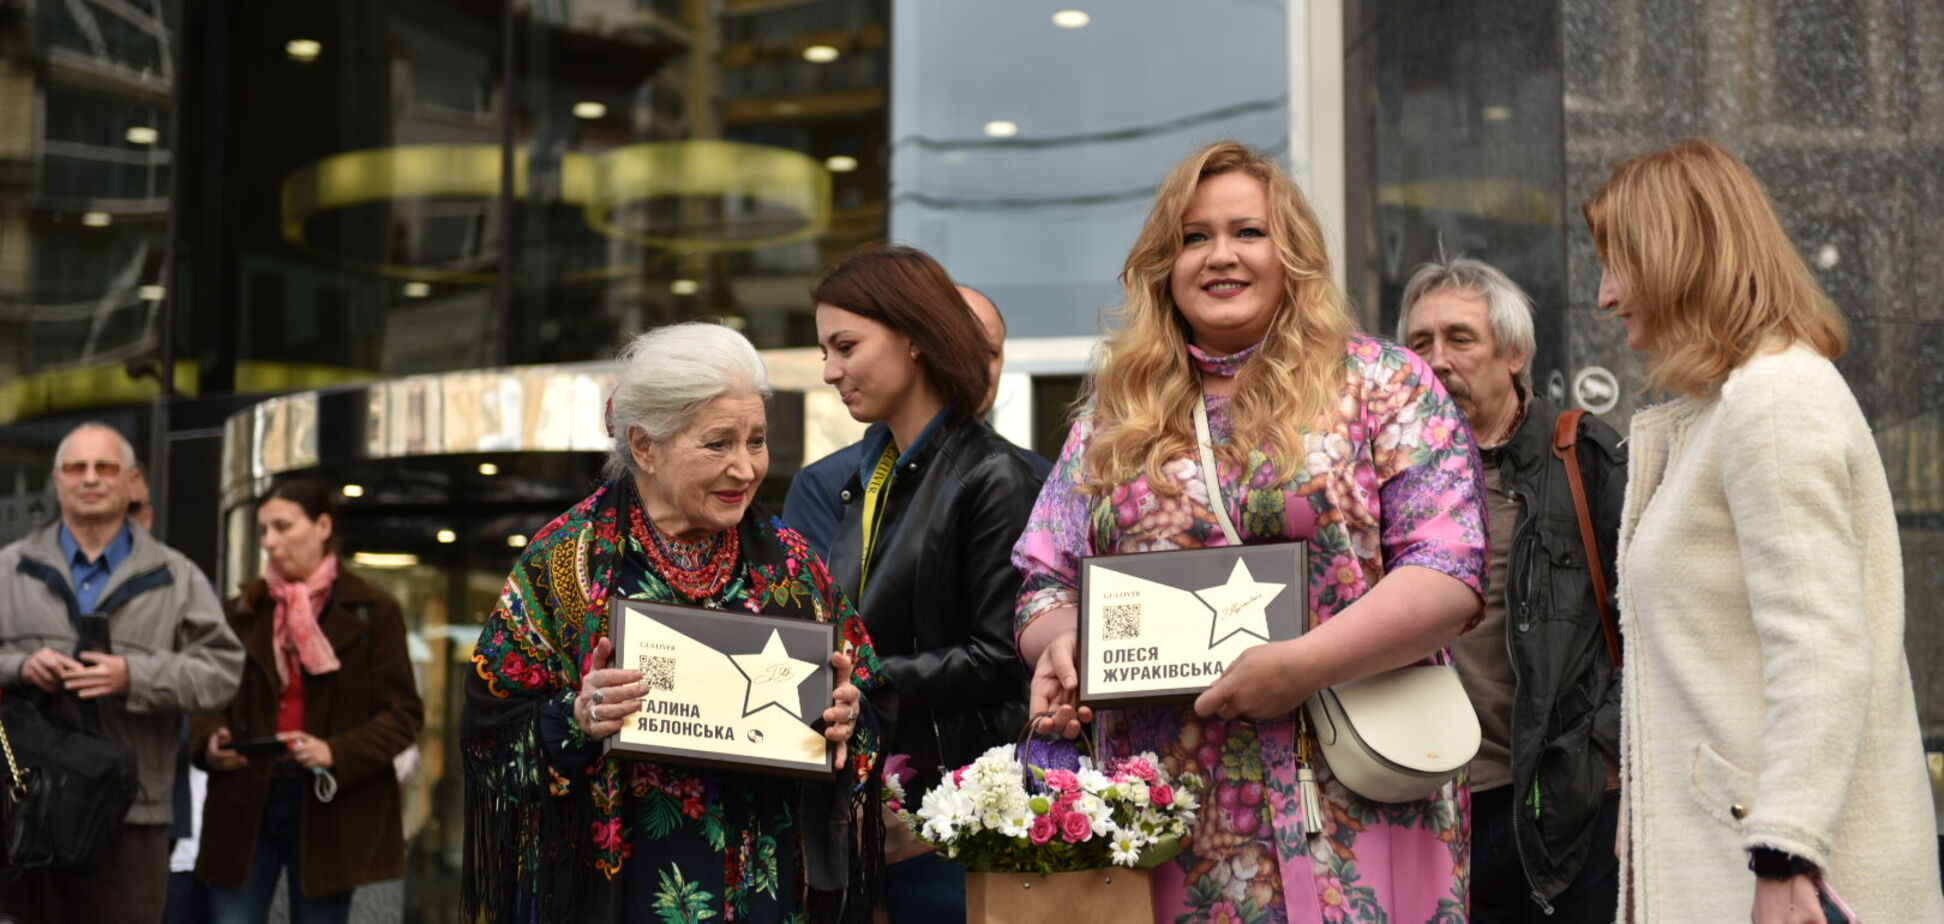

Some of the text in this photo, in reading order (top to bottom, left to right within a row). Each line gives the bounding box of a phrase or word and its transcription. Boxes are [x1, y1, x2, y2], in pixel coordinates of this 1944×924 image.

[1103, 647, 1158, 664] ОЛЕСЯ
[1103, 661, 1224, 683] ЖУРАКІВСЬКА
[640, 698, 701, 718] ГАЛИНА
[638, 717, 735, 741] ЯБЛОНСЬКА
